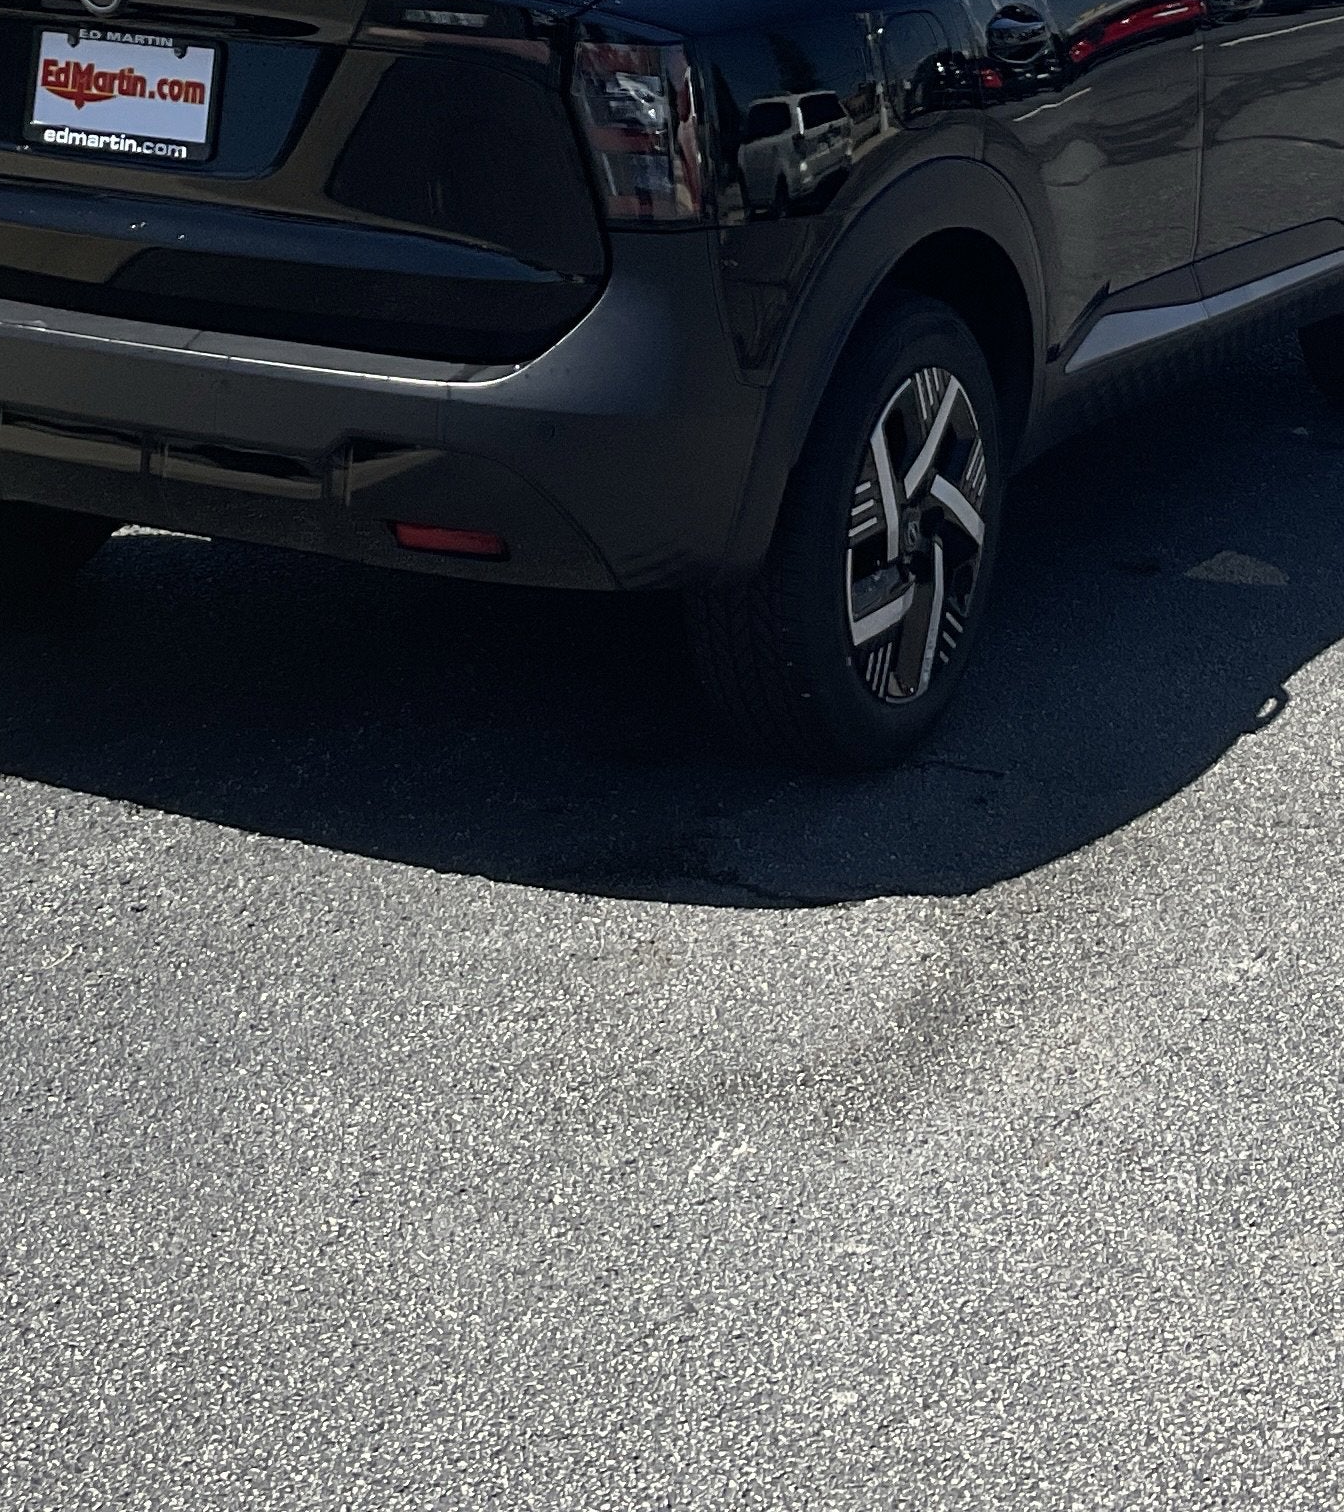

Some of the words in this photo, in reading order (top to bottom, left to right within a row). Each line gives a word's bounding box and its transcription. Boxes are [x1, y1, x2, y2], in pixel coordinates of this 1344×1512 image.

[79, 28, 102, 40] ED
[107, 31, 174, 48] MARTIN
[41, 59, 206, 106] EdMartin.com
[43, 128, 188, 159] edmartin.com
